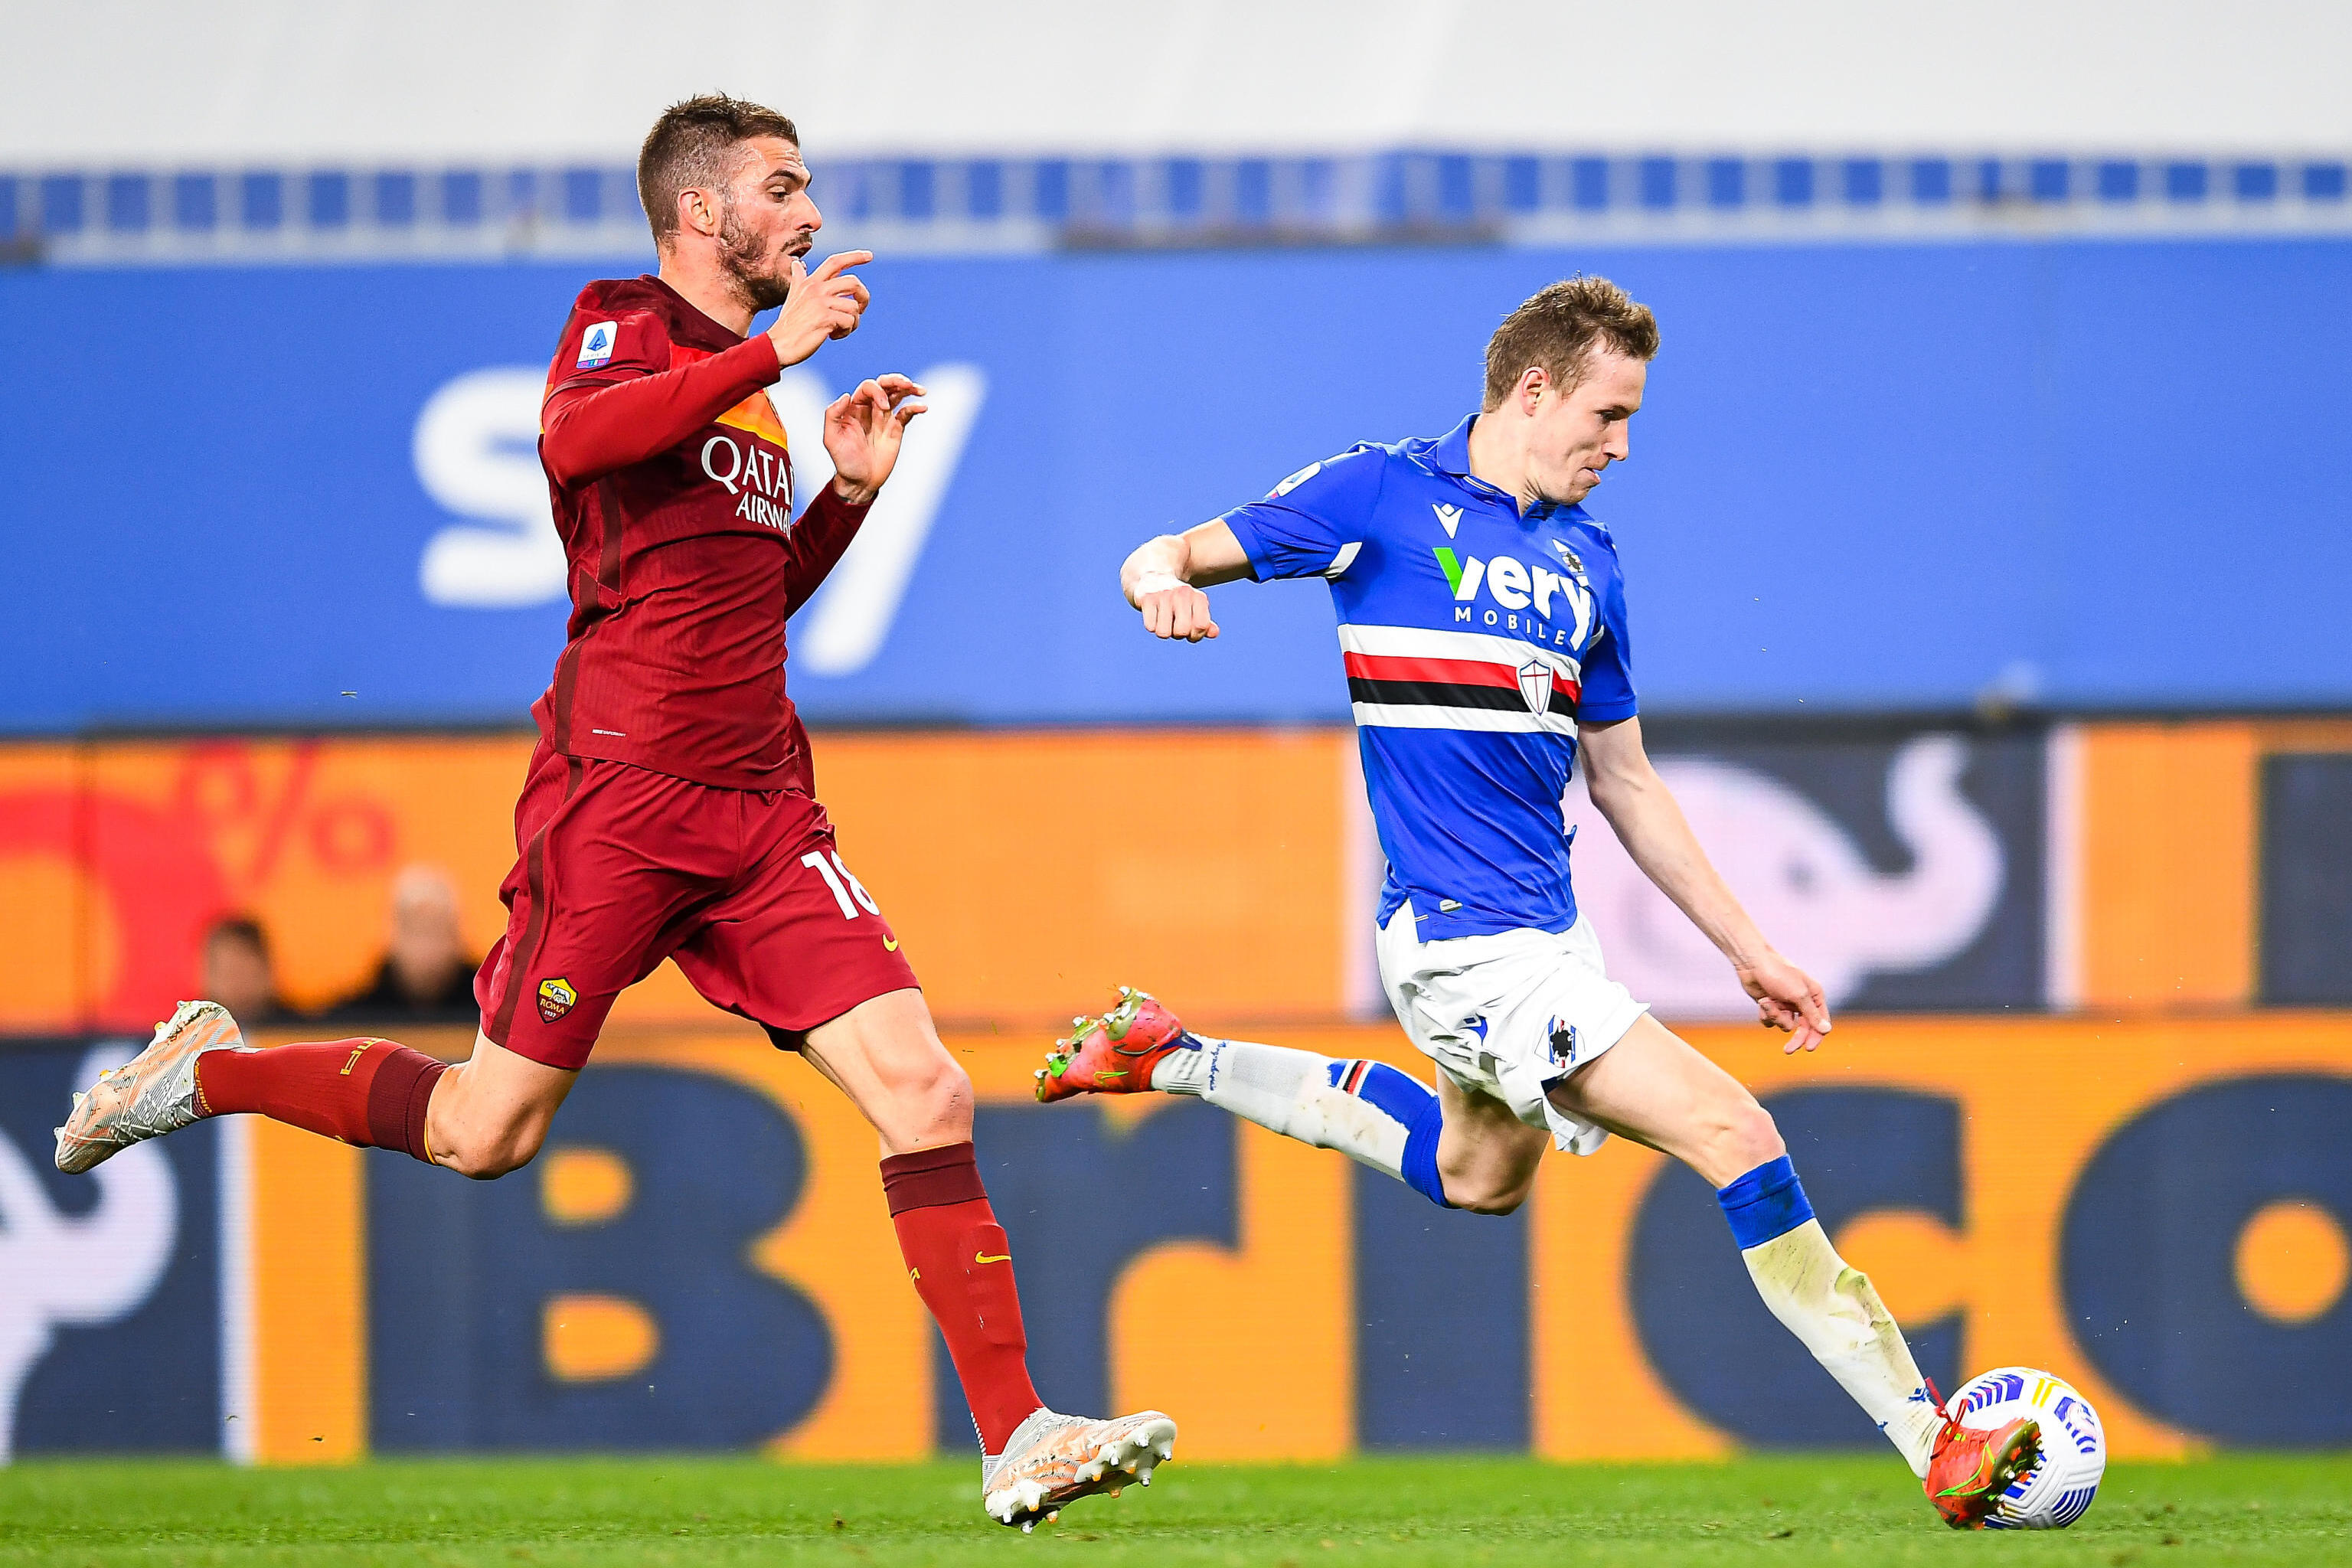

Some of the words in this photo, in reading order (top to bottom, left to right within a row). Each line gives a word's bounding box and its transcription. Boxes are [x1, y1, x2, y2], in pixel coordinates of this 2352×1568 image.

[413, 366, 986, 675] sy
[735, 491, 792, 541] AIRWA
[1432, 547, 1592, 652] very
[1455, 606, 1567, 645] MOBILE
[800, 850, 880, 920] 18
[540, 998, 564, 1014] ROMA
